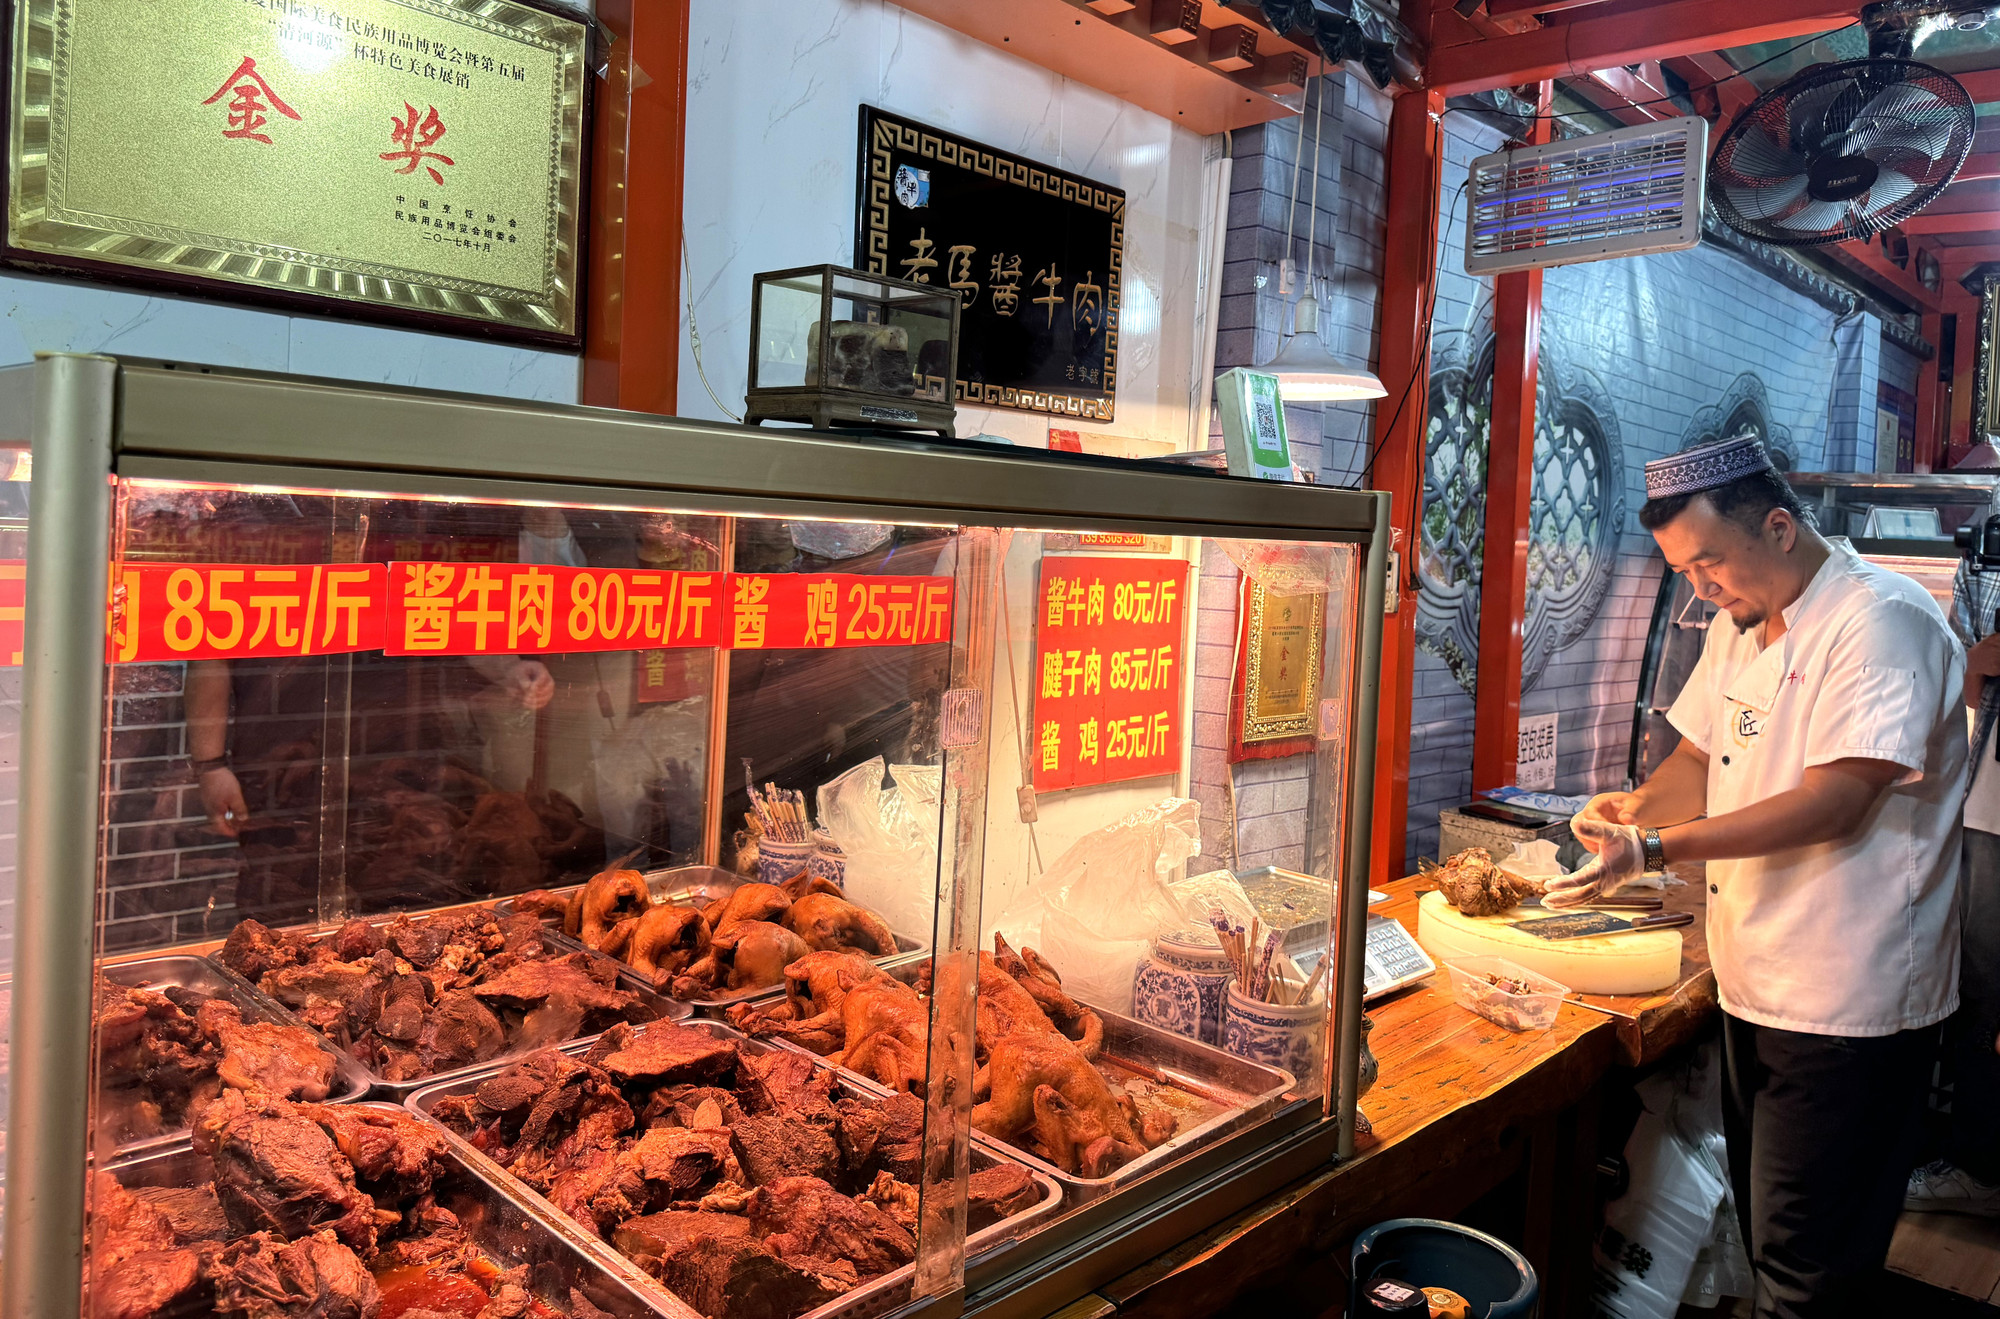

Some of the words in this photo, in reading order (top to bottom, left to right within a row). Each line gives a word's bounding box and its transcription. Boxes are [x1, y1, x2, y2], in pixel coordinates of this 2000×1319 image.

[162, 565, 371, 655] 85元/斤
[403, 563, 554, 651] 酱牛肉
[567, 571, 713, 645] 80元/斤
[846, 582, 948, 643] 25元/斤
[1046, 576, 1105, 627] 酱牛肉
[1113, 578, 1176, 625] 80元/斤
[1041, 647, 1102, 699] 腱子肉
[1110, 644, 1173, 692] 85元/斤
[1106, 710, 1170, 760] 25元/斤
[1516, 722, 1554, 765] 空包装费
